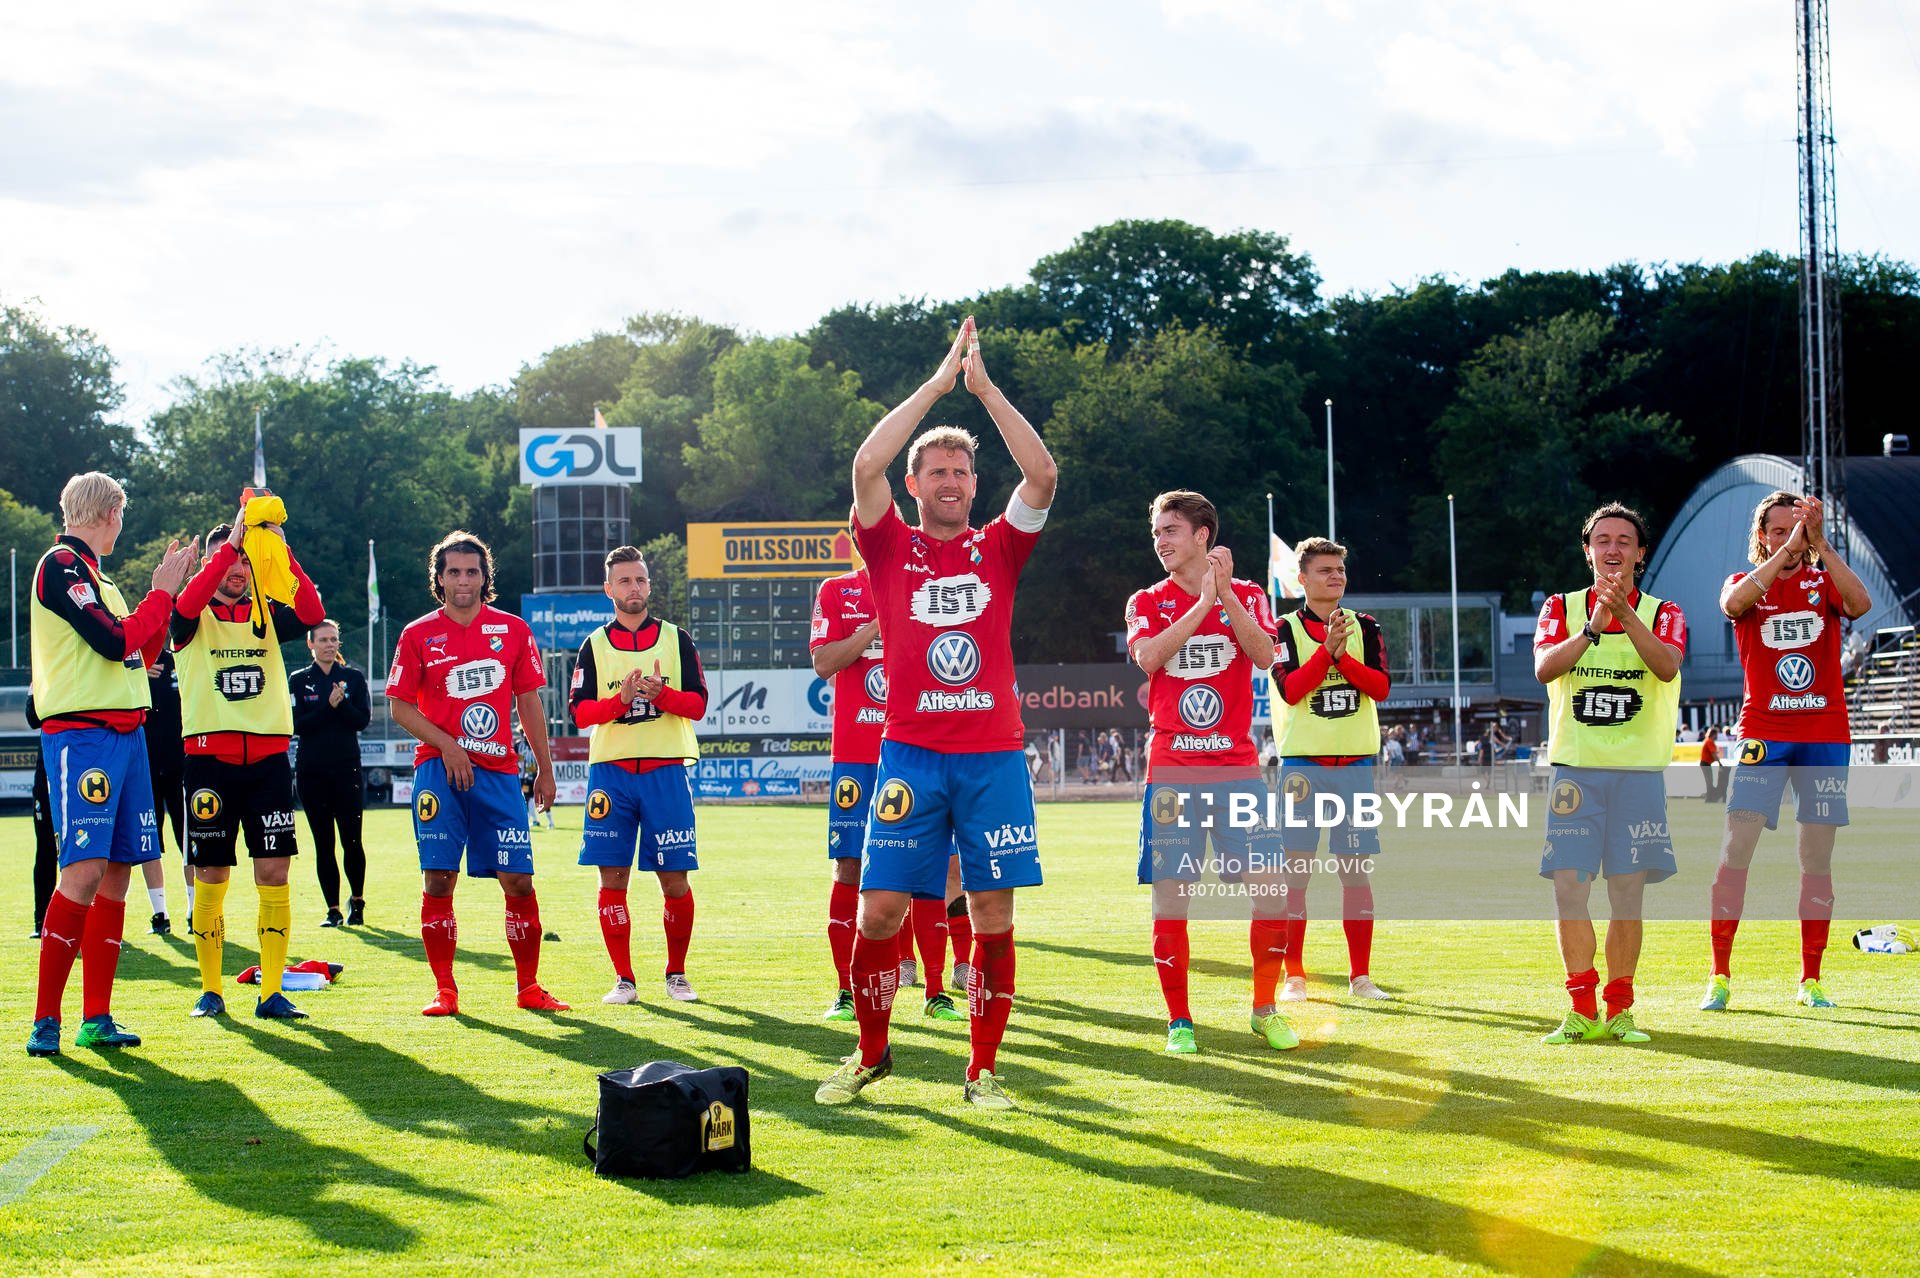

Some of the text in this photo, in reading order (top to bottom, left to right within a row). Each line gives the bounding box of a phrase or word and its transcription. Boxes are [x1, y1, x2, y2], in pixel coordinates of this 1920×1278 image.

[525, 434, 636, 477] GDL
[725, 538, 832, 561] OHLSSONS
[928, 583, 977, 615] IST
[1771, 618, 1814, 641] IST
[1178, 642, 1224, 670] IST
[222, 671, 261, 694] IST
[456, 665, 496, 692] IST
[918, 688, 994, 711] Atteviks
[1322, 690, 1358, 712] IST
[1583, 691, 1632, 719] IST
[1769, 693, 1827, 709] Atteviks
[707, 716, 771, 725] MDROC
[198, 736, 207, 748] 12
[457, 737, 507, 756] Atteviks
[1172, 733, 1233, 750] Atteviks
[1816, 802, 1829, 817] 10
[141, 835, 152, 852] 21
[264, 836, 276, 851] 12
[1347, 833, 1360, 848] 15
[497, 851, 509, 865] 88
[1630, 847, 1639, 864] 2
[990, 859, 1002, 880] 5
